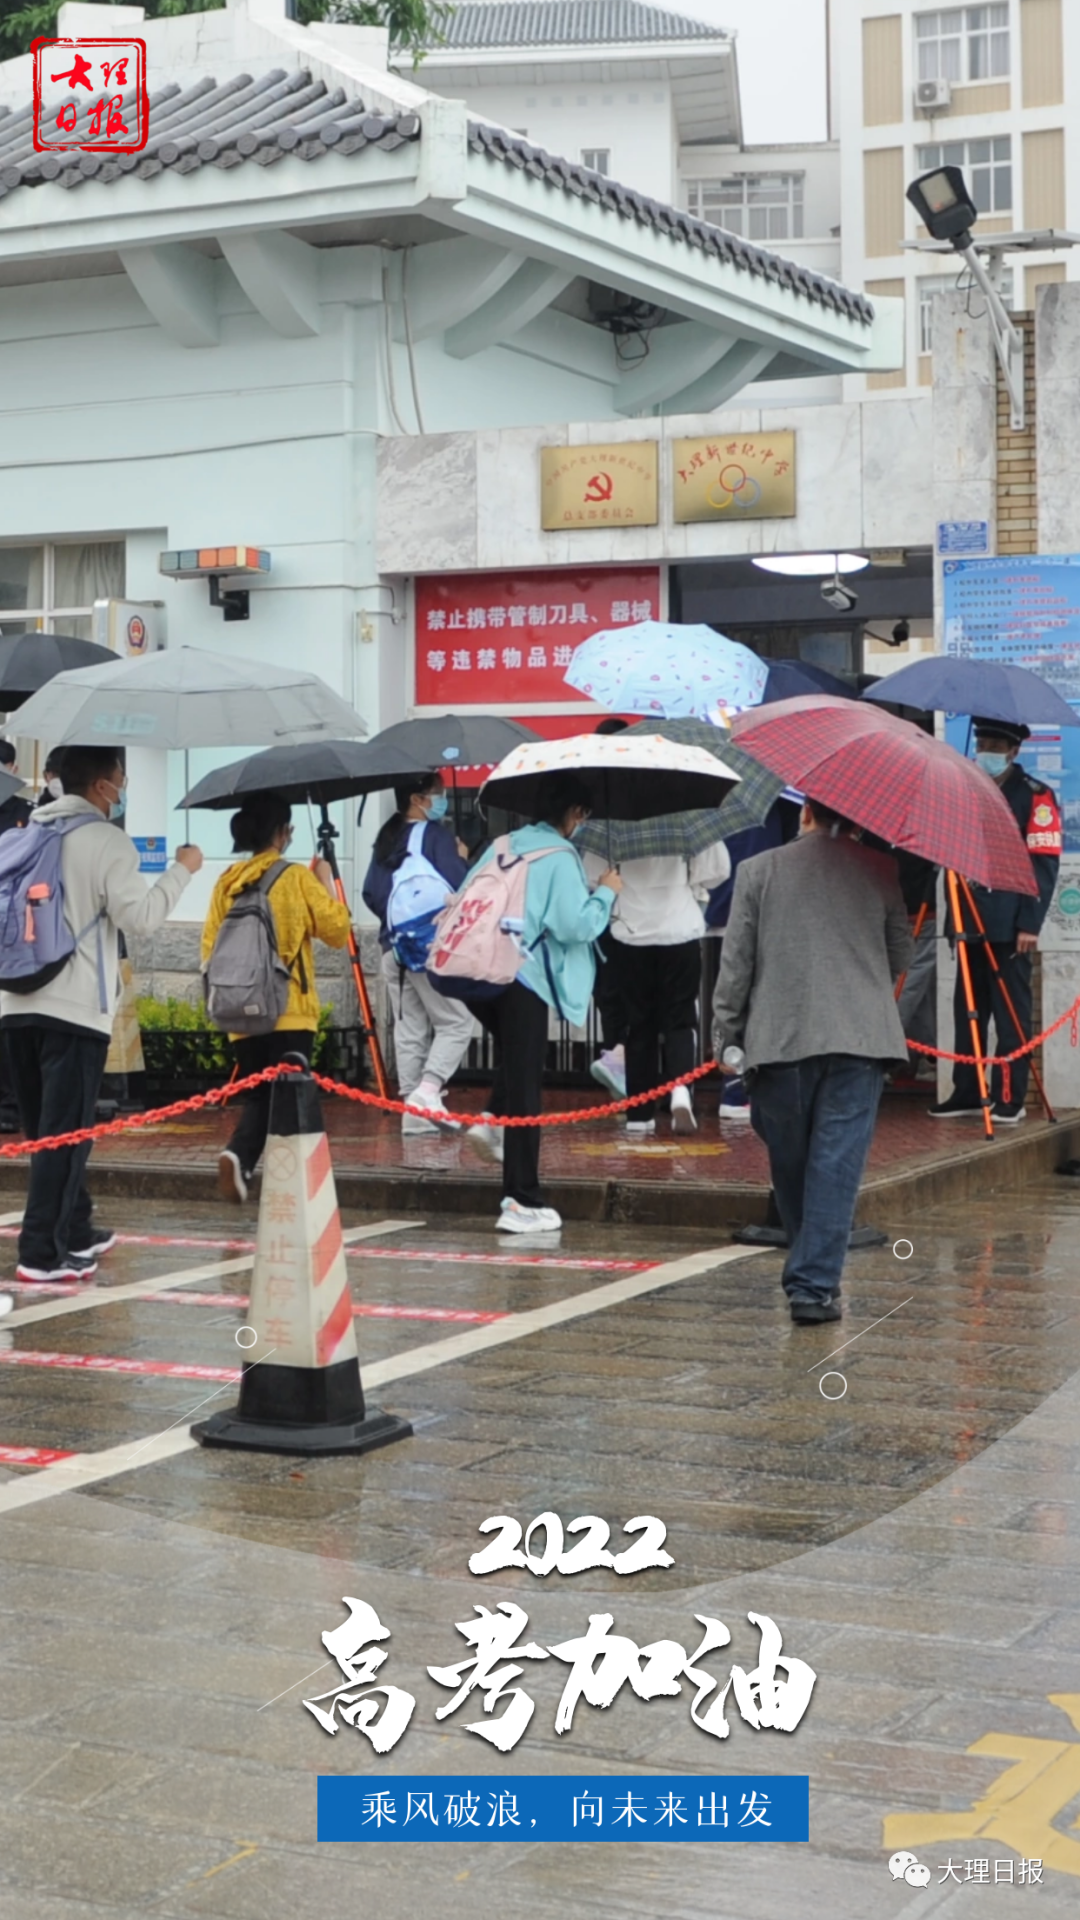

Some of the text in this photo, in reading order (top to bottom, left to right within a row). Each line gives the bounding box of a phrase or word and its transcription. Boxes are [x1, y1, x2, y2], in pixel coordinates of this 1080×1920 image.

[677, 442, 790, 484] 大理新世纪中学
[427, 600, 652, 631] 禁止携带管制刀具、器械
[427, 645, 574, 672] 等违禁物品进
[264, 1191, 297, 1348] 禁止停车
